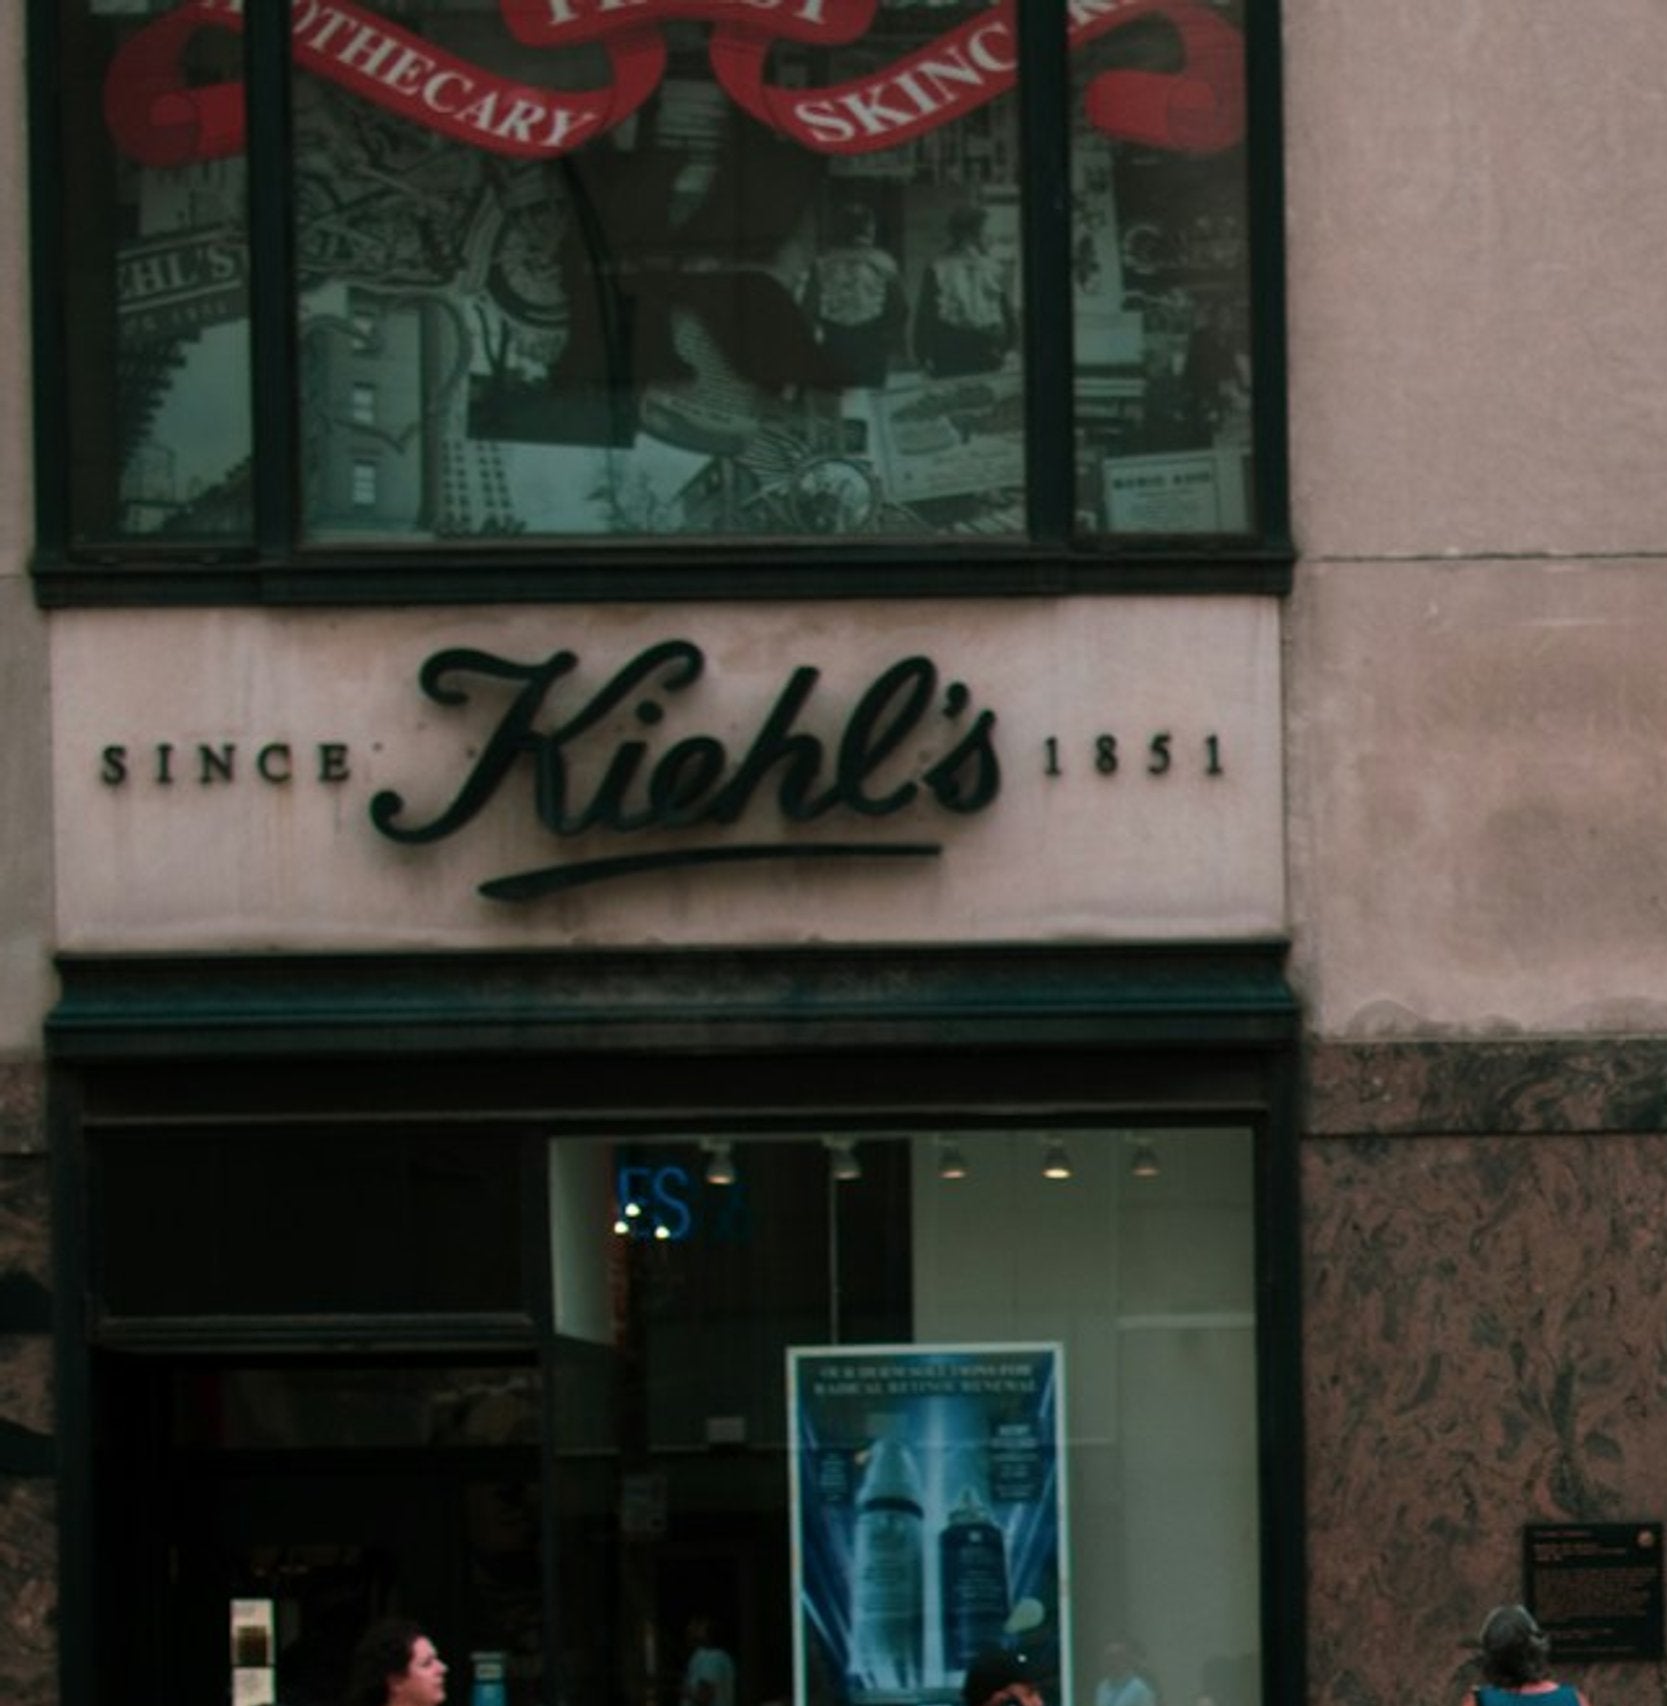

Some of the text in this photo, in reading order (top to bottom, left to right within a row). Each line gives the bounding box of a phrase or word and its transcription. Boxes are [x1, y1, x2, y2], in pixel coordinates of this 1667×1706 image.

[100, 742, 352, 786] SINCE
[369, 640, 1000, 845] Kiehl's
[1043, 734, 1225, 779] 1851
